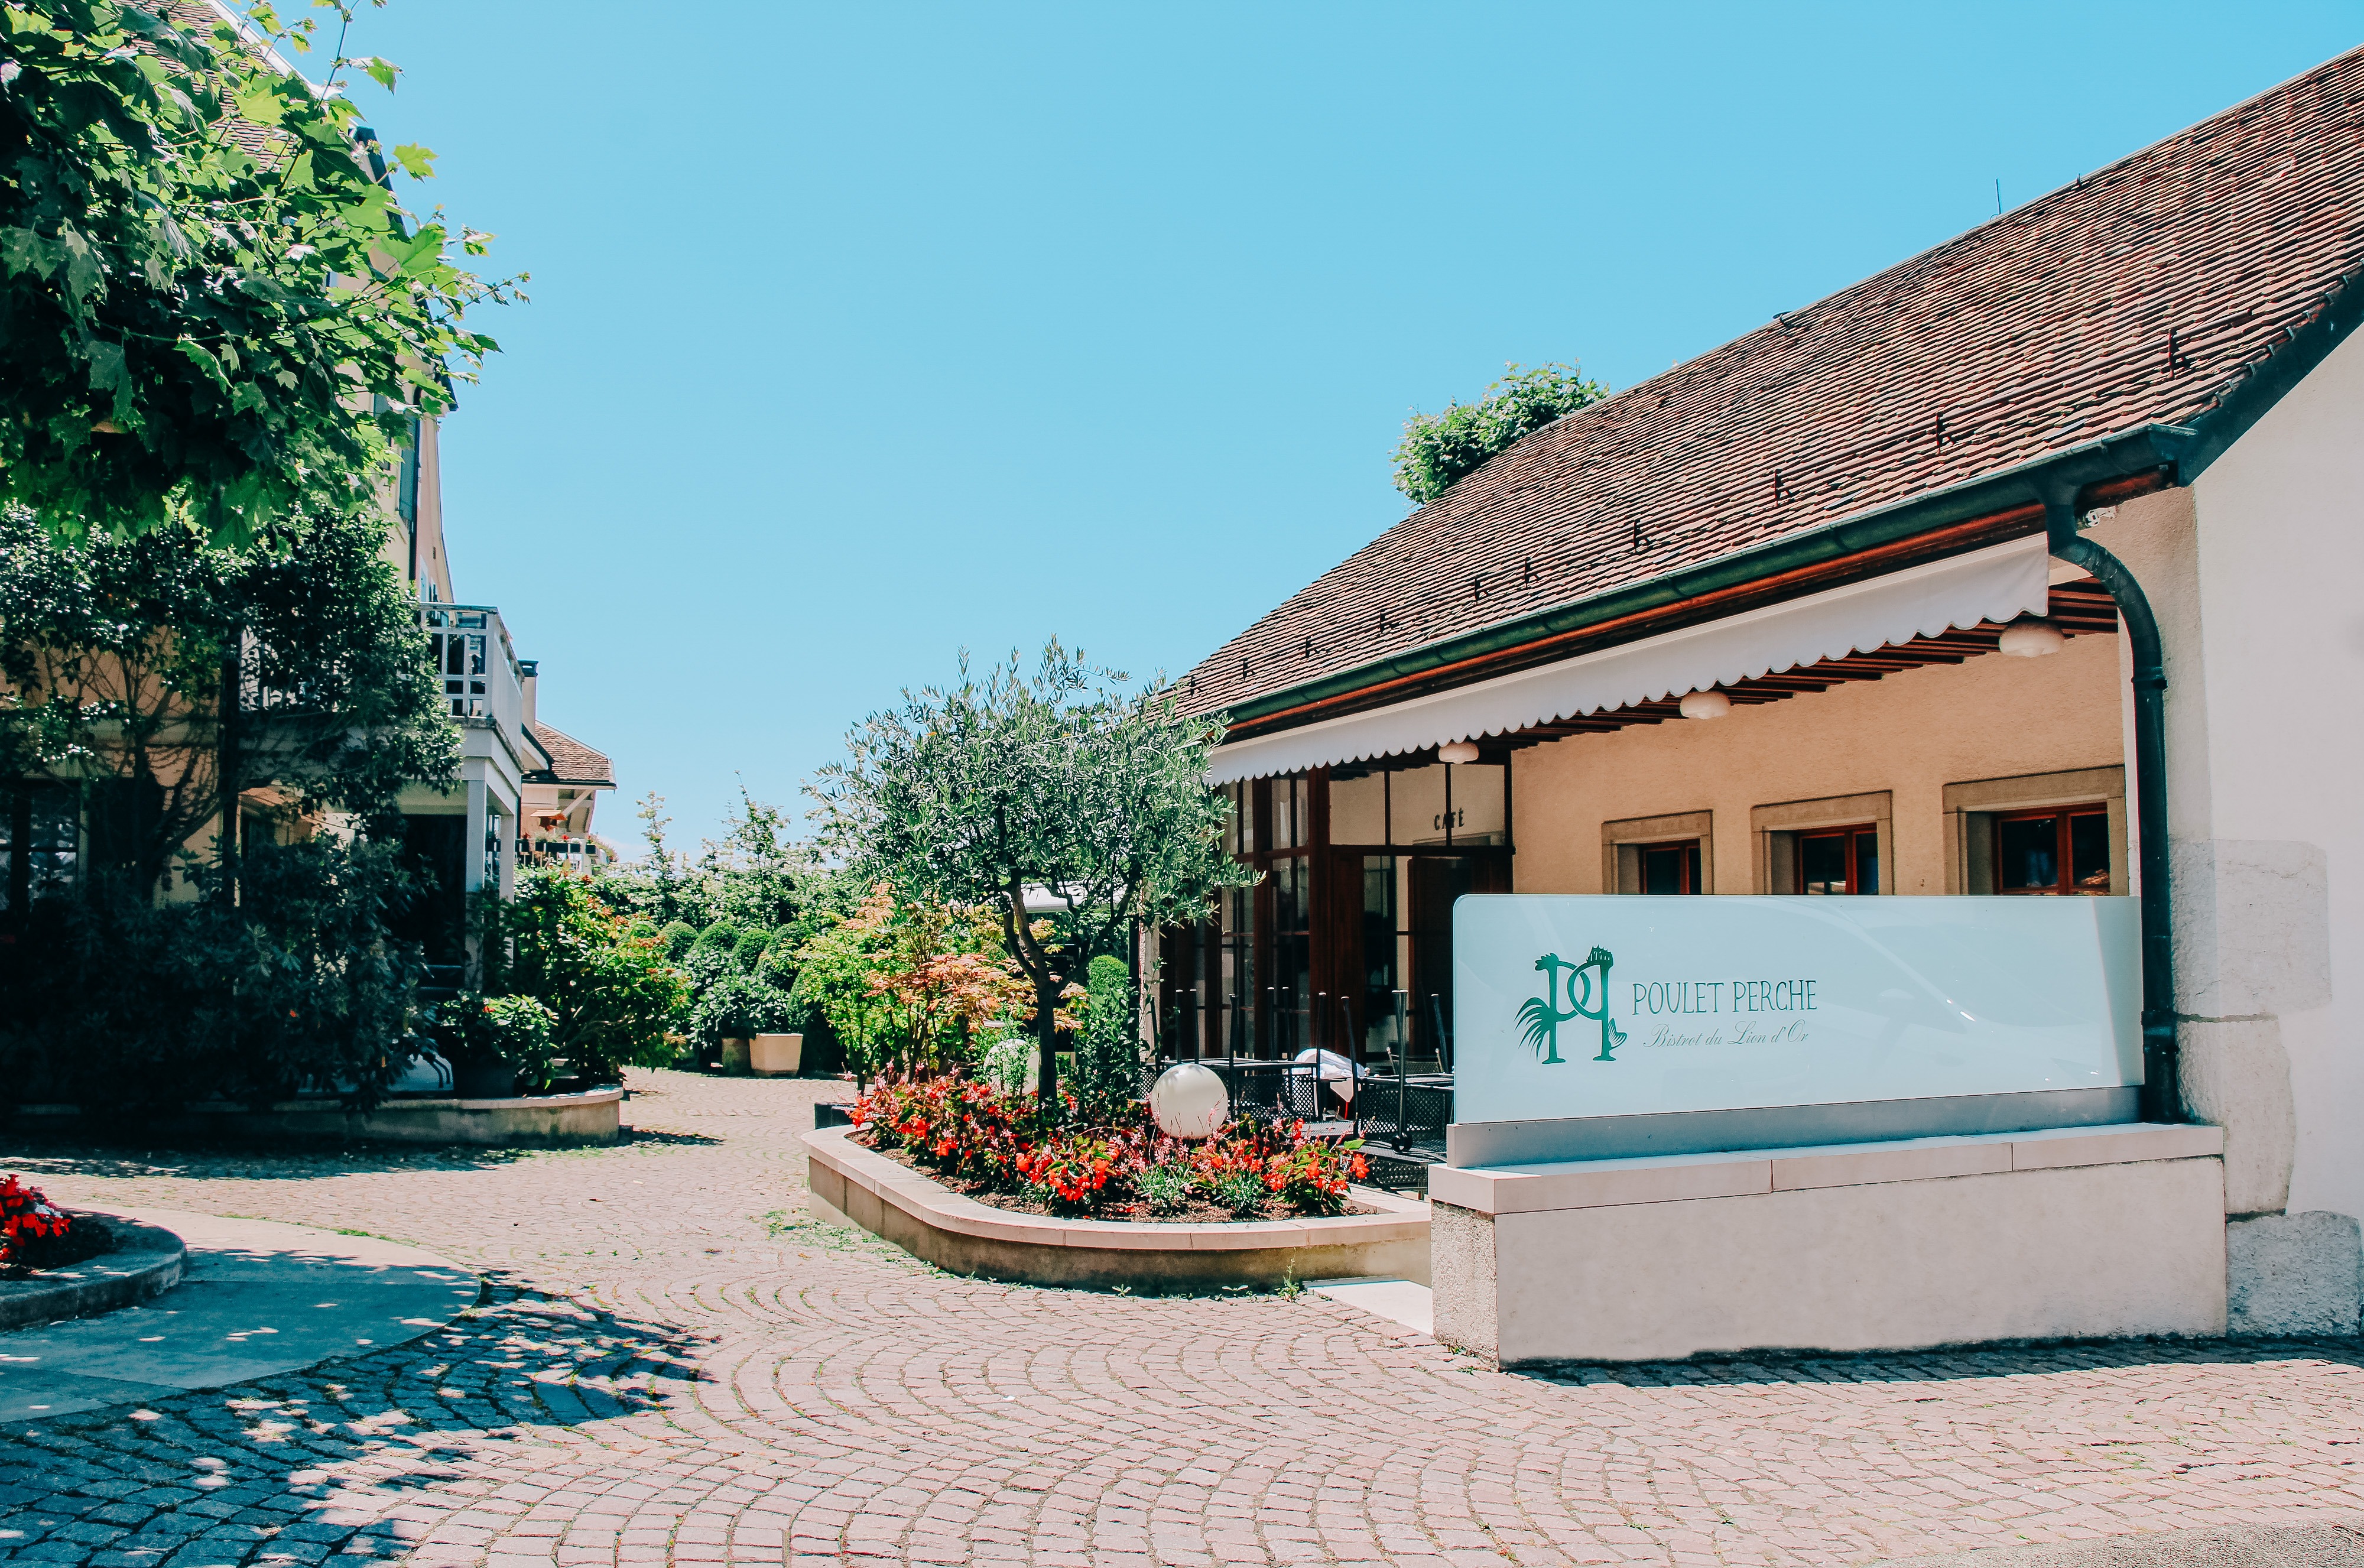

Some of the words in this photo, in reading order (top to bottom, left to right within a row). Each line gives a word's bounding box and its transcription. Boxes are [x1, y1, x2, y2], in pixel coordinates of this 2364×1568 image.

[1632, 982, 1725, 1015] POULET
[1732, 979, 1817, 1012] PERCHE
[1642, 1023, 1704, 1048] Bistrot
[1705, 1028, 1723, 1046] du
[1727, 1020, 1766, 1045] Lion
